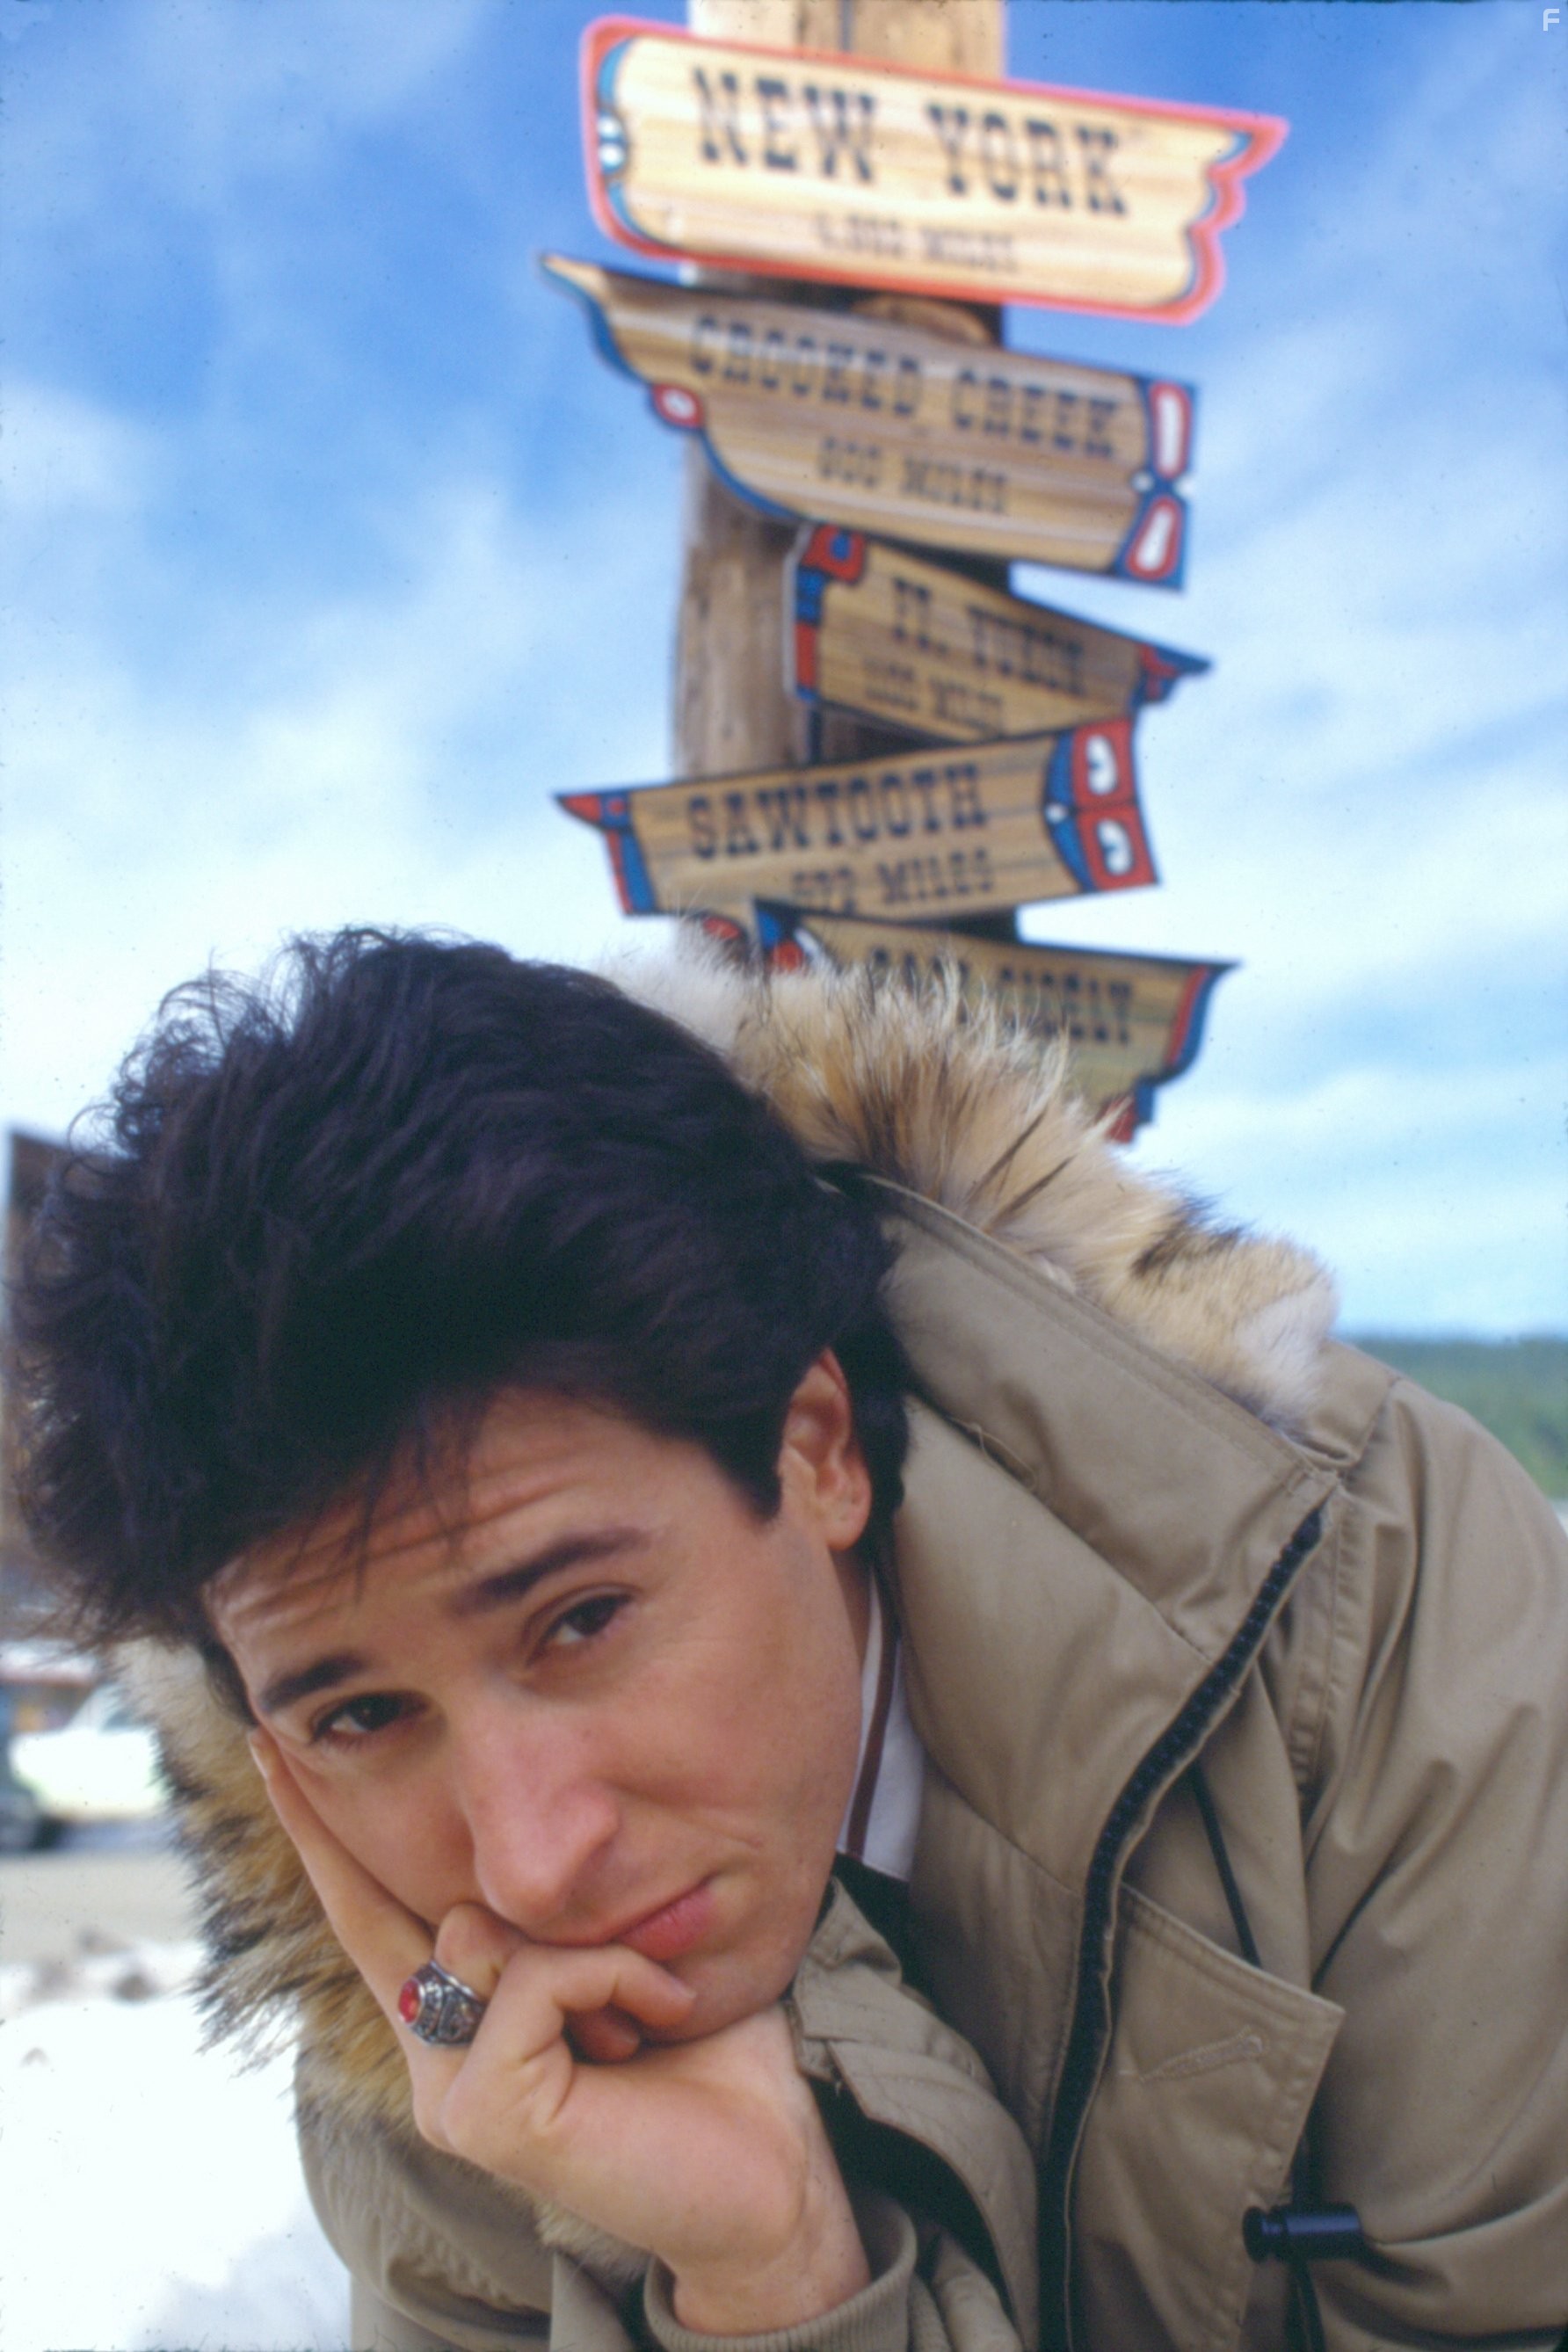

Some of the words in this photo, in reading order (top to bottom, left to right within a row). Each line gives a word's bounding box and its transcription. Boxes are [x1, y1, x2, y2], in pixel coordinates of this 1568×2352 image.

[693, 66, 877, 185] NEW
[926, 101, 1127, 216] YORK
[691, 315, 924, 417] CROOKED
[951, 368, 1122, 460] CREEK
[686, 761, 988, 860] SAWTOOTH
[876, 849, 994, 902] MILES
